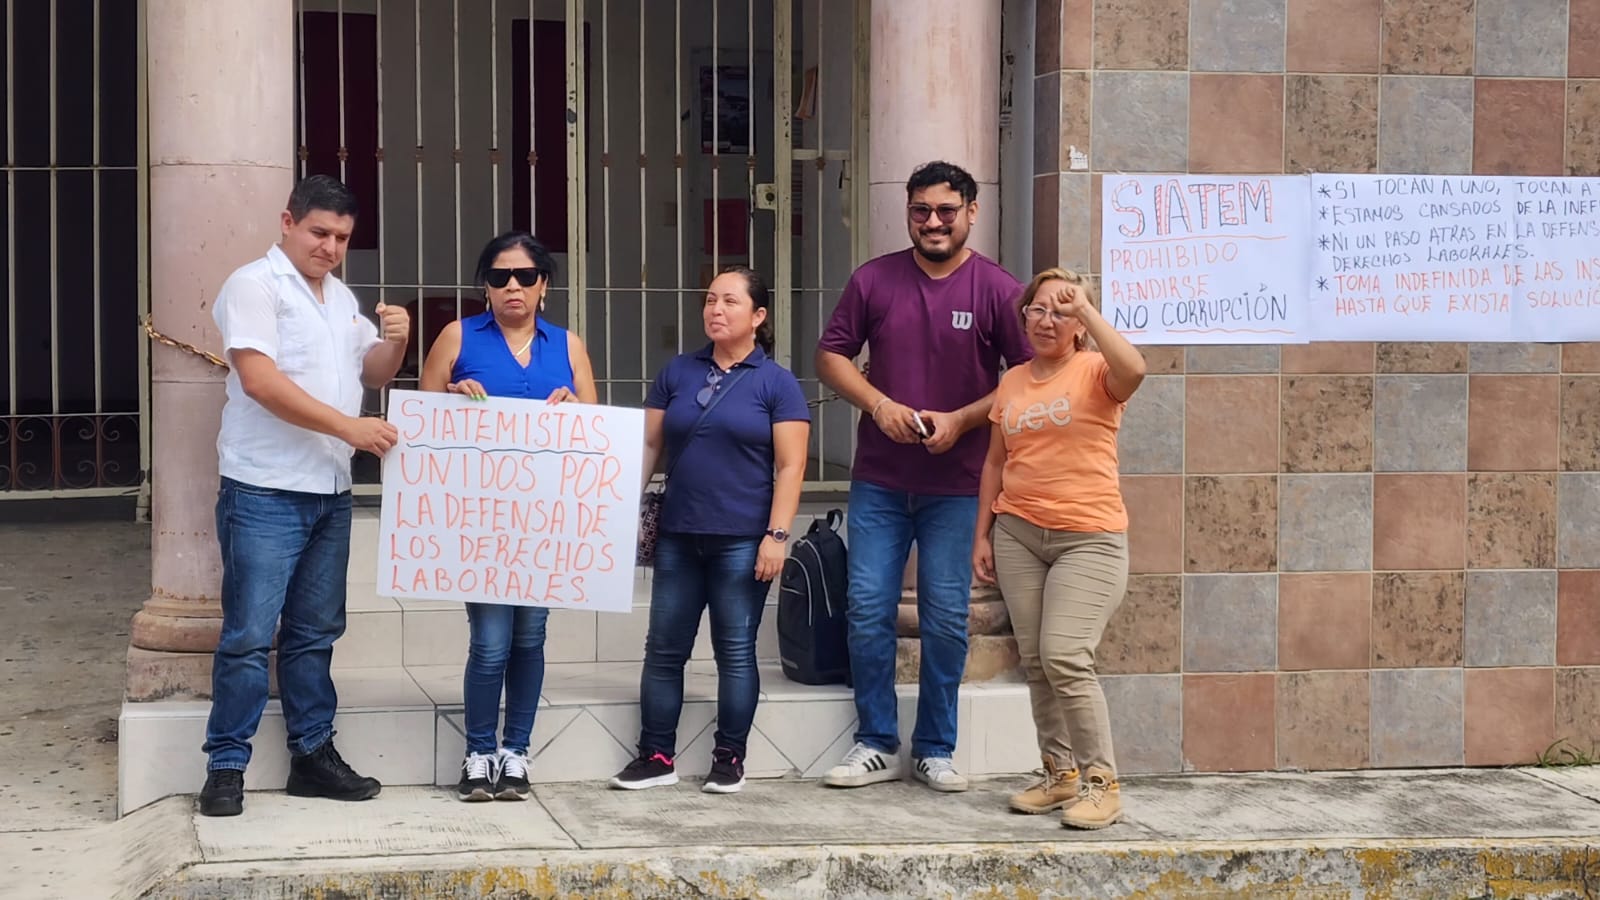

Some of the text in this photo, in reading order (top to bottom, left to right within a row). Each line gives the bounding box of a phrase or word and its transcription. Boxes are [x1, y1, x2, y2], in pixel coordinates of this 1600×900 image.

[1335, 181, 1356, 199] SI
[1375, 178, 1434, 196] TOCAN
[1442, 179, 1453, 198] A
[1460, 180, 1501, 195] UNO,
[1515, 181, 1571, 197] TOCAN
[1582, 184, 1592, 196] A
[1112, 179, 1272, 237] SIATEM
[1332, 206, 1404, 226] ESTAMOS
[1419, 201, 1502, 218] CANSADOS
[1517, 201, 1532, 214] DE
[1539, 200, 1556, 214] LA
[1331, 232, 1348, 252] NI
[1356, 232, 1375, 249] UN
[1385, 231, 1420, 248] PASO
[1429, 226, 1475, 244] ATRAS
[1487, 222, 1507, 239] EN
[1516, 222, 1535, 240] LA
[1110, 242, 1238, 272] PROHIBIDO
[1333, 244, 1534, 272] DERECHOS LABORALES.
[1111, 274, 1209, 305] RENDIRSE
[1334, 274, 1381, 295] TOMA
[1396, 267, 1492, 290] INDEFINIDA
[1504, 264, 1525, 286] DE
[1535, 261, 1563, 281] LAS
[1114, 305, 1148, 329] NO
[1336, 296, 1385, 317] HASTA
[1393, 295, 1431, 315] QUE
[1448, 293, 1509, 313] EXISTA
[401, 399, 610, 451] SIATEMISTAS
[1004, 396, 1072, 435] Lee
[400, 451, 623, 501] UNIDOS POR
[397, 492, 610, 538] LA DEFENSA DE
[391, 534, 614, 572] LOS DERECHOS
[392, 565, 589, 602] LABORALES.
